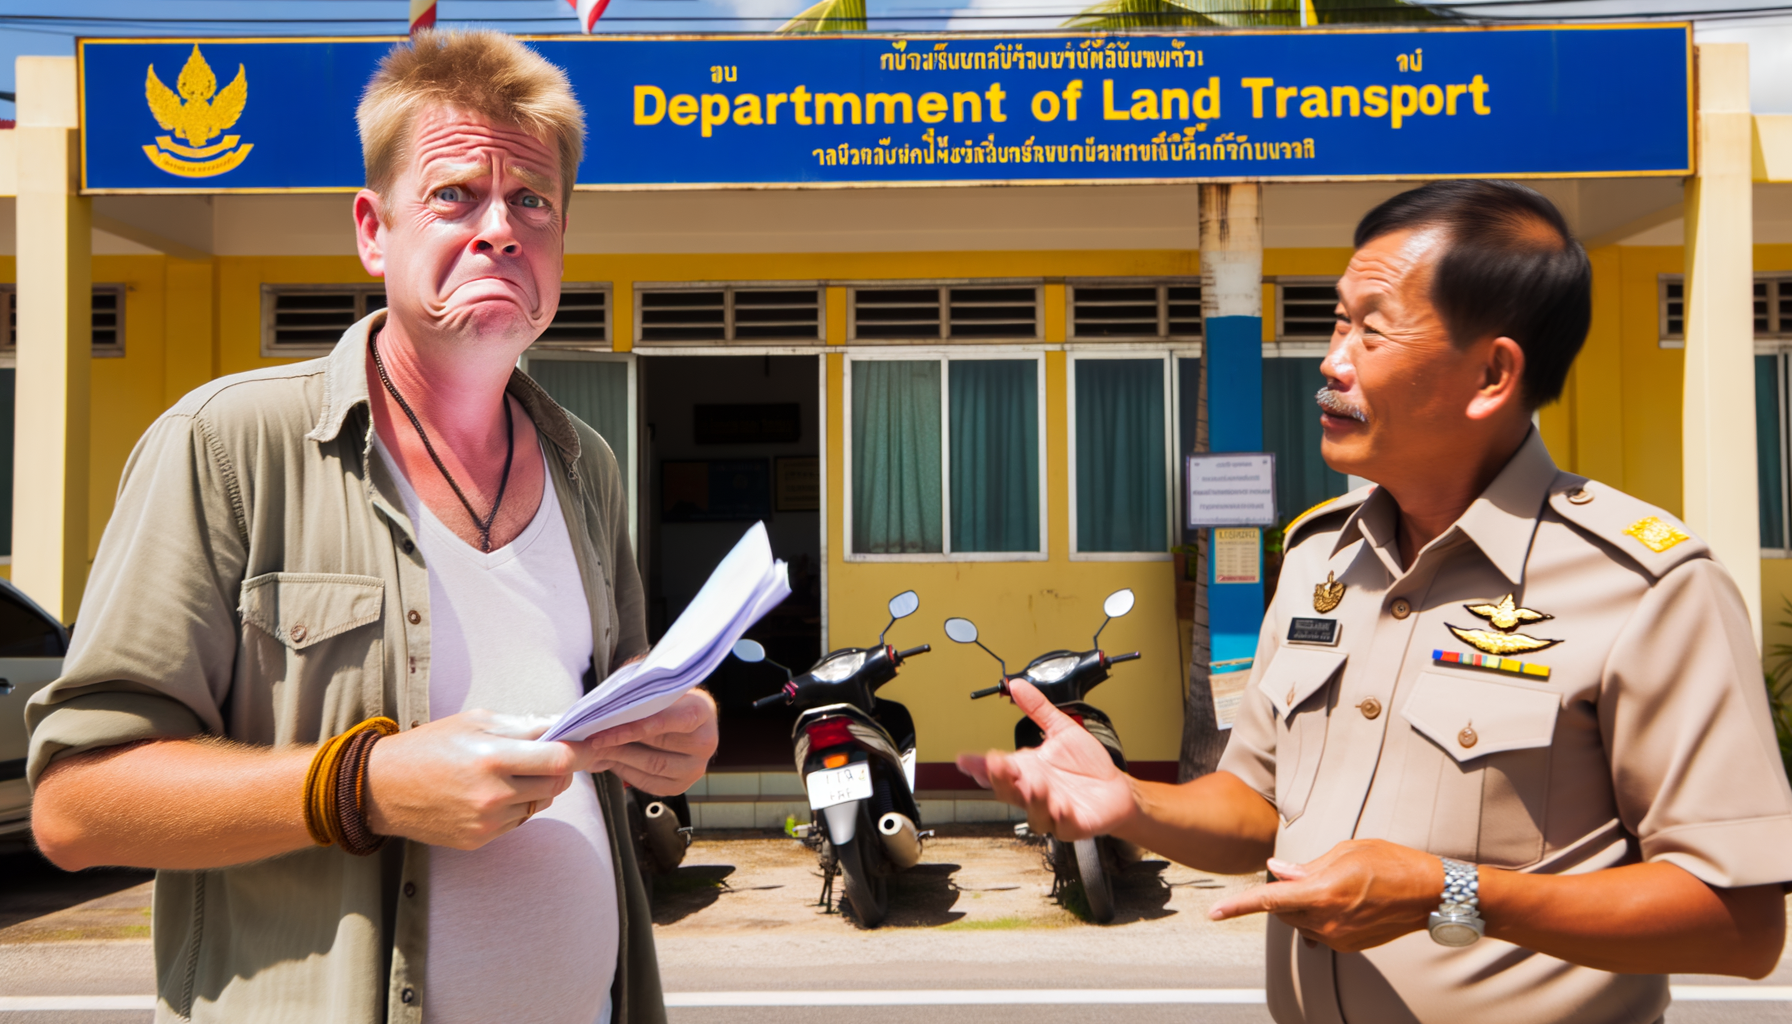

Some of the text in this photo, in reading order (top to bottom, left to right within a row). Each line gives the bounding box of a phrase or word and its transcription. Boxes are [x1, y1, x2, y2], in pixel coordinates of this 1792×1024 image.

[633, 74, 1492, 138] Departmment of Land Transport
